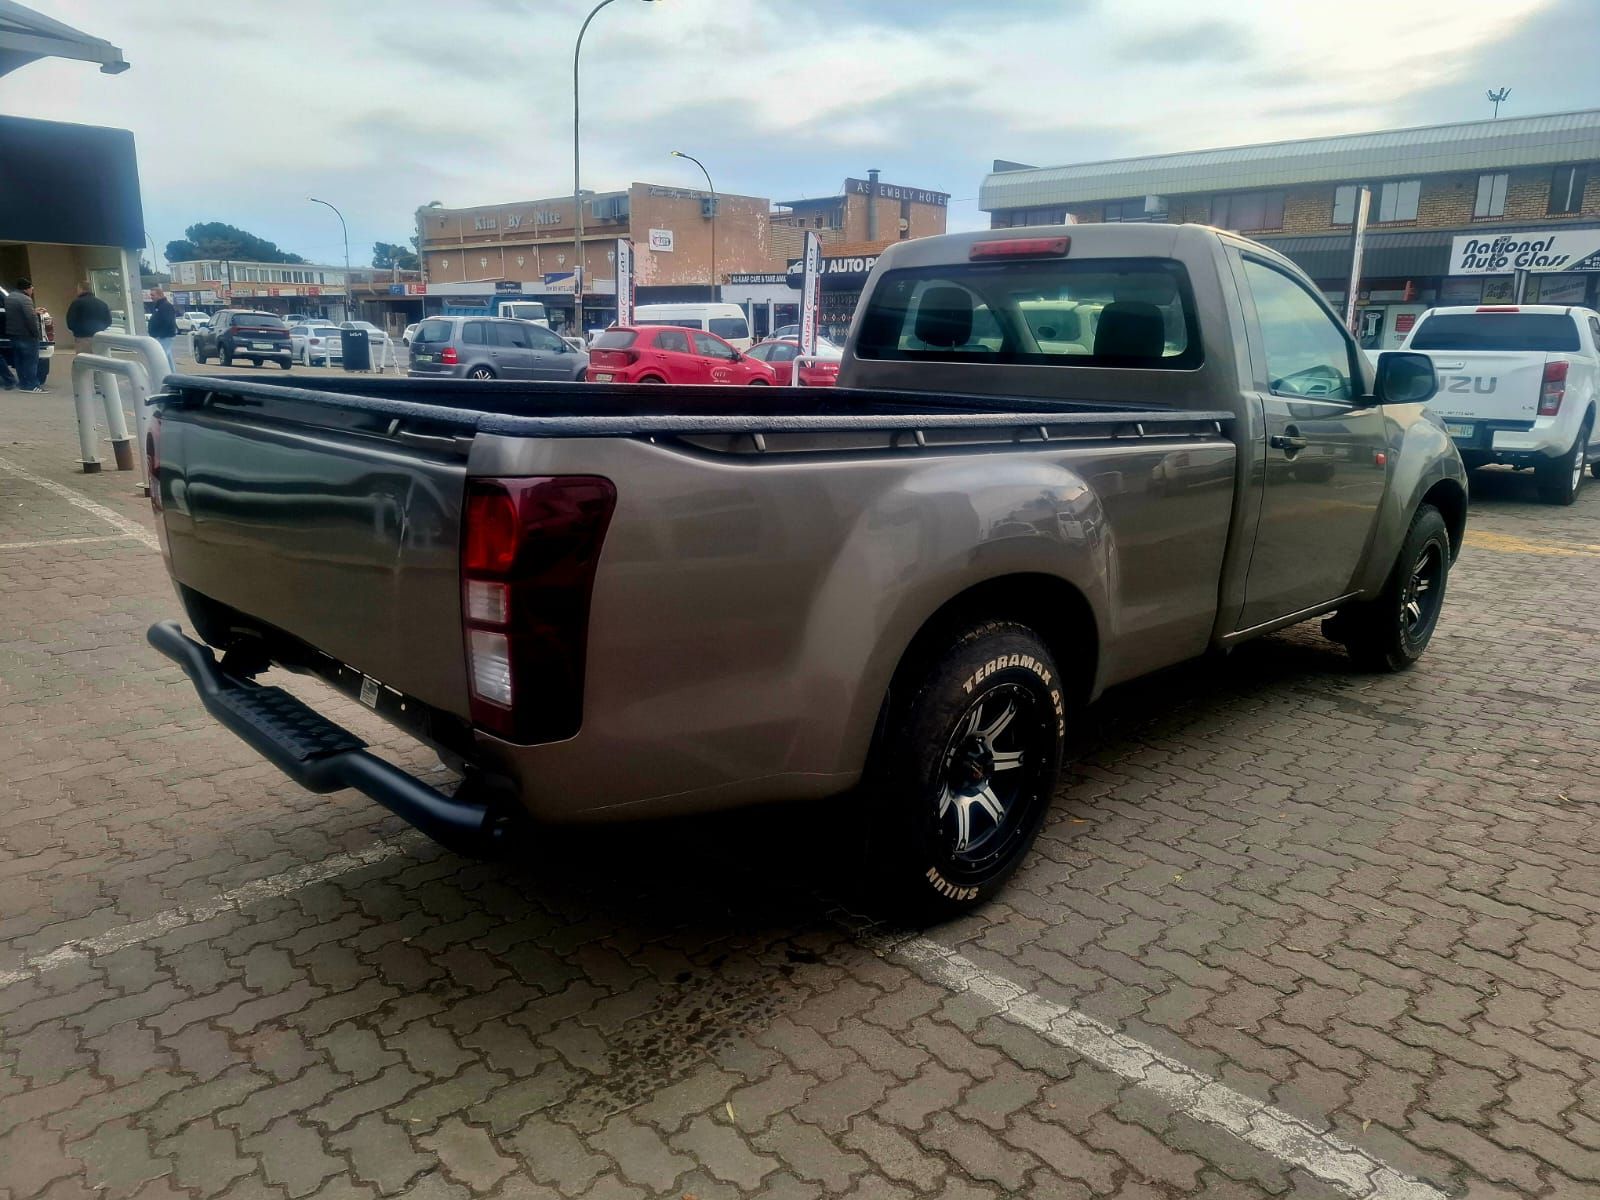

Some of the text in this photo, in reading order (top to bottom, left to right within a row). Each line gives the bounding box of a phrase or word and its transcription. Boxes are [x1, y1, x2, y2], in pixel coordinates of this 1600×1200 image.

[857, 182, 947, 206] ASEMBLY HOTEL
[508, 214, 521, 229] By
[1463, 236, 1555, 255] National
[828, 258, 864, 273] AUTO
[1461, 251, 1570, 269] Auto Glass
[804, 315, 812, 348] ISUZU
[962, 654, 1052, 694] TERRAMAX
[925, 866, 979, 901] SAILUN
